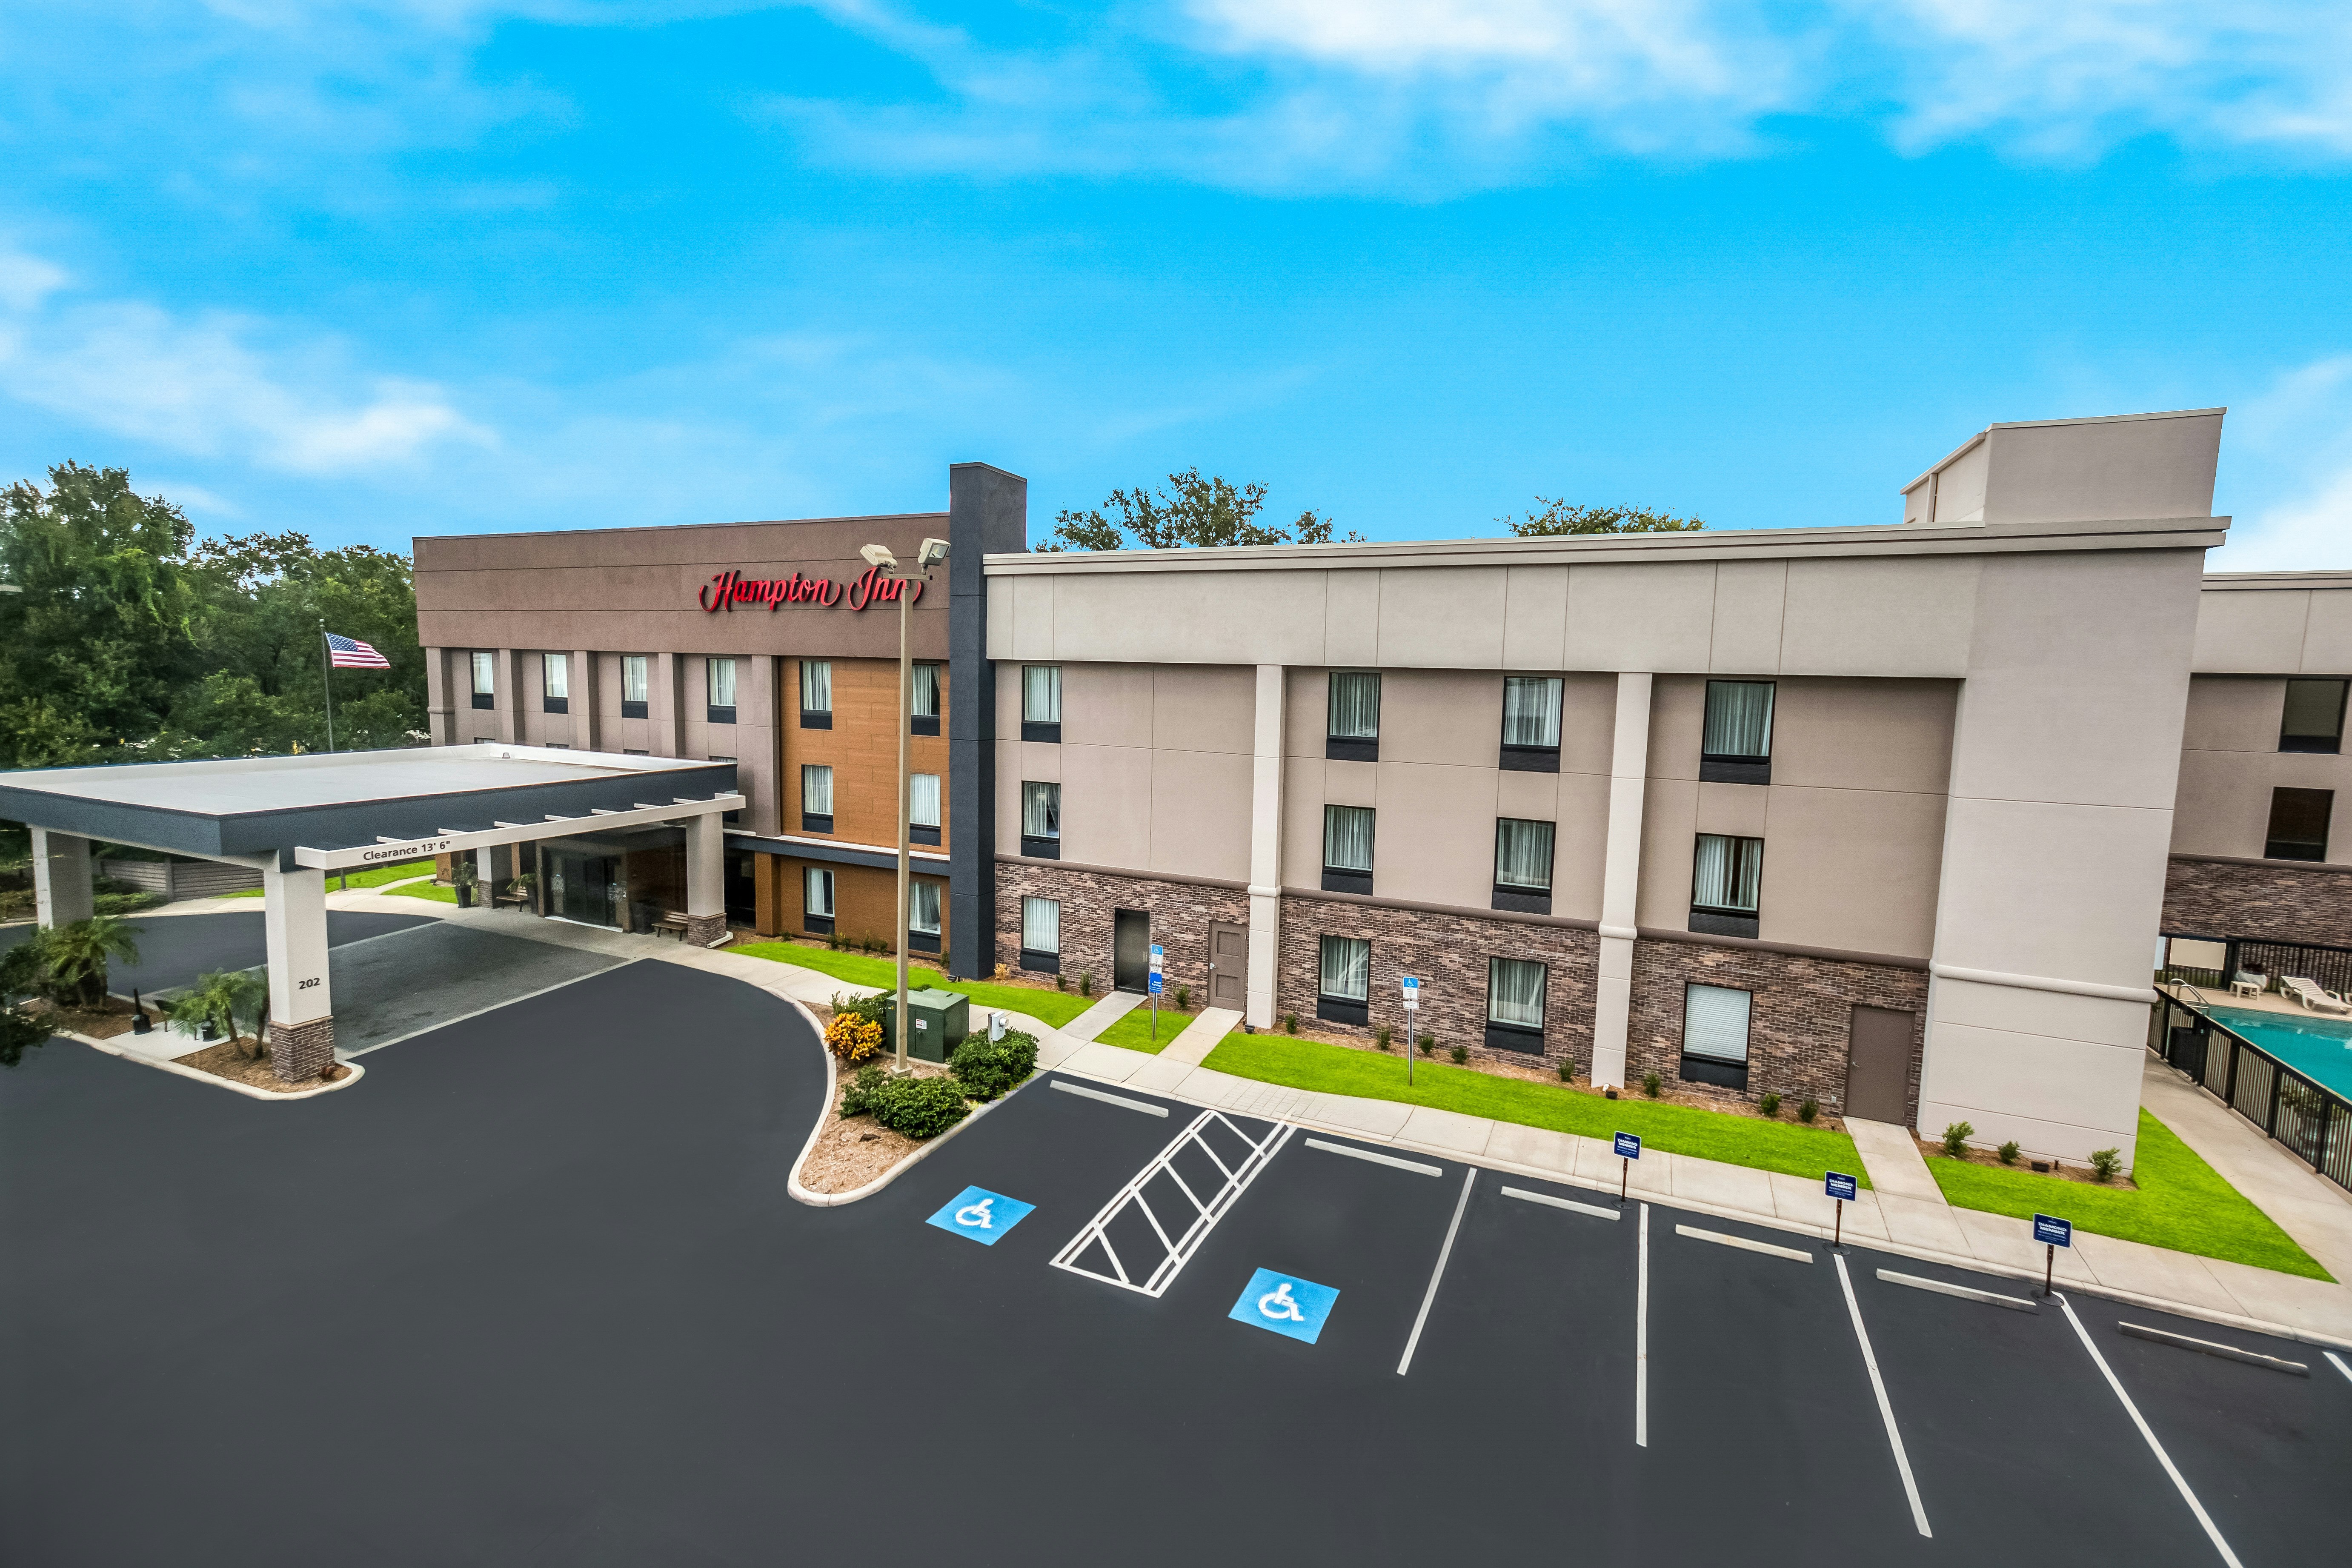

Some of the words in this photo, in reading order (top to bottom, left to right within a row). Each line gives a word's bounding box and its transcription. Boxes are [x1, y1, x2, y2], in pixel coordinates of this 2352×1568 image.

[699, 569, 843, 612] Hampton
[363, 847, 418, 860] Clearance
[421, 843, 436, 852] 13'
[299, 977, 321, 990] 202
[1617, 1138, 1638, 1146] DIAMOND
[1829, 1179, 1853, 1187] DIAMOND
[2037, 1222, 2067, 1232] DIAMOND
[2039, 1226, 2066, 1236] MEMBER
